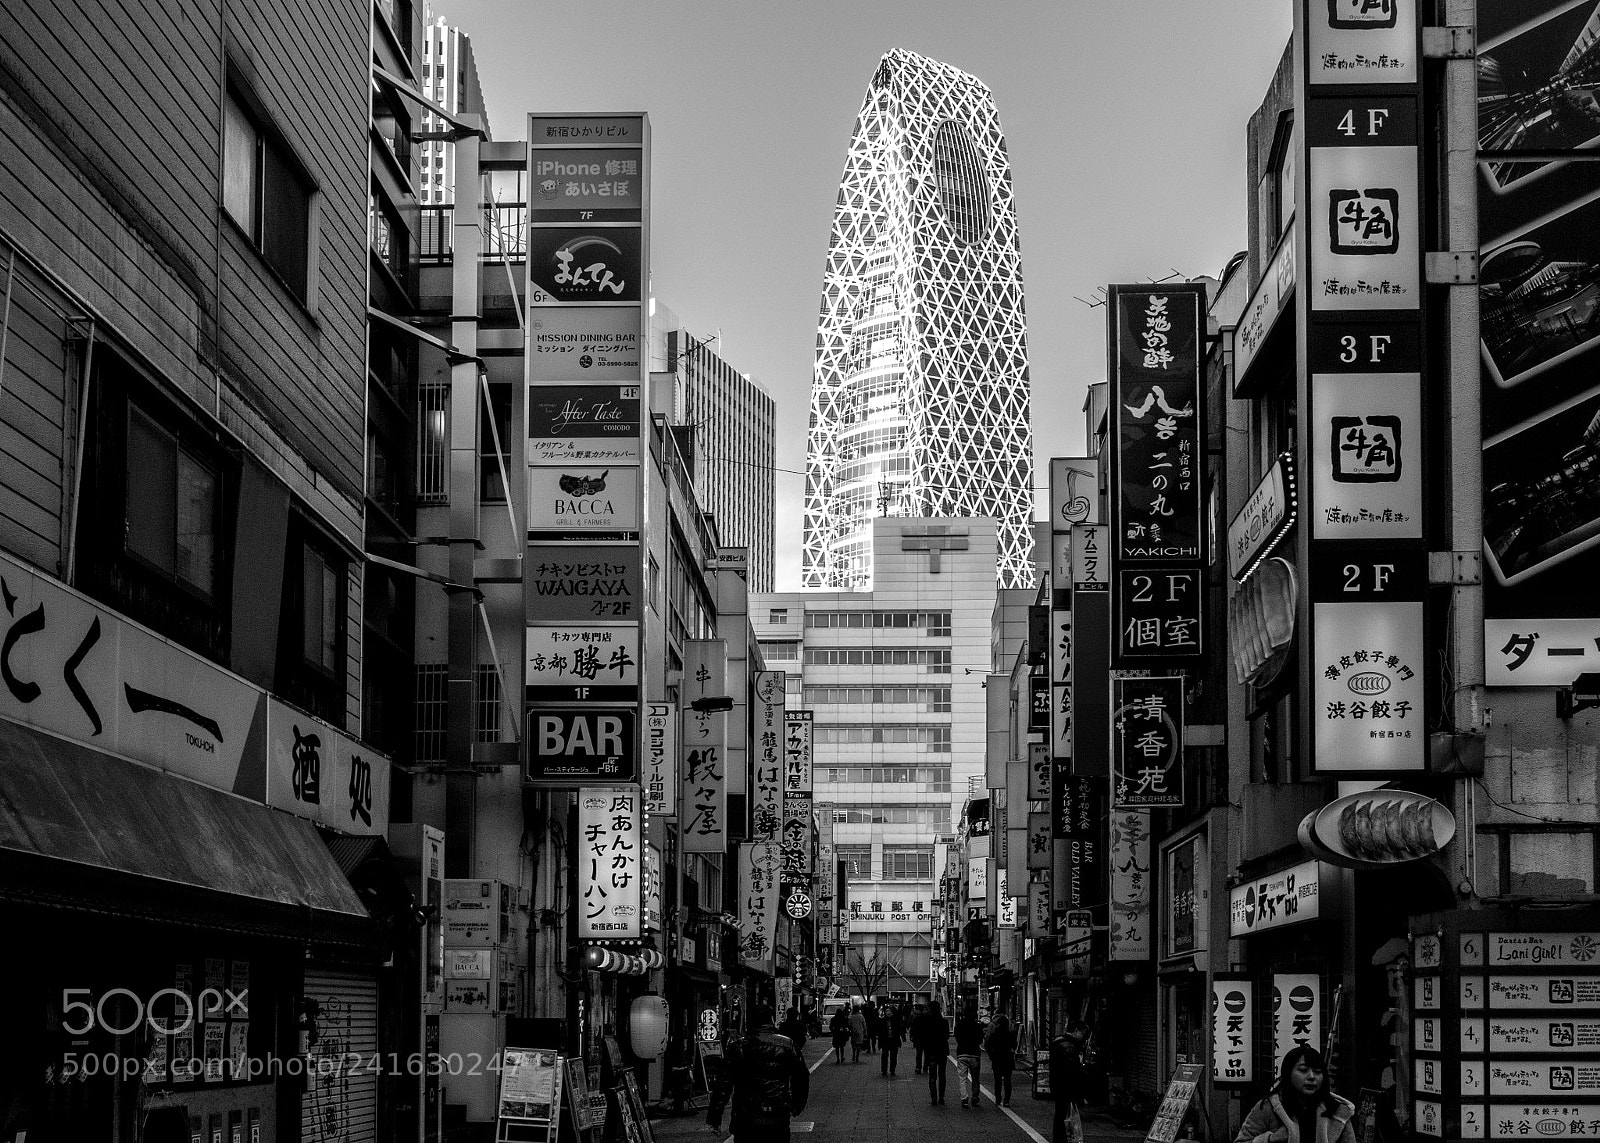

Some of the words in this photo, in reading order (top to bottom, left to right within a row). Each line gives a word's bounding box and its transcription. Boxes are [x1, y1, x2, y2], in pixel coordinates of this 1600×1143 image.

[546, 125, 629, 137] 新宿ひかりビル
[1336, 108, 1389, 136] 4F
[536, 160, 601, 176] iPhone
[604, 159, 638, 177] 修理
[565, 181, 630, 197] あいさぽ
[579, 210, 594, 220] 7F
[1338, 200, 1392, 240] 牛角
[553, 247, 625, 295] まんてん
[533, 290, 548, 302] 6F
[537, 333, 578, 342] MISSION
[580, 333, 614, 342] DINING
[615, 333, 636, 342] BAR
[536, 345, 575, 353] ミッション
[582, 345, 636, 353] ダイニングバー
[1339, 335, 1392, 363] 3F
[623, 388, 639, 398] 4F
[551, 397, 590, 434] After
[591, 400, 624, 421] Taste
[1340, 427, 1395, 468] 牛角
[1178, 439, 1191, 491] 新宿西口
[1147, 452, 1175, 517] 二の丸
[554, 499, 615, 515] BACCA
[1083, 527, 1098, 582] オムニクス
[1124, 546, 1198, 557] YAKICHI
[535, 562, 628, 578] チキンビストロ
[1342, 563, 1396, 592] 2F
[534, 578, 632, 597] WAIGAYA
[1131, 574, 1193, 603] 2F
[612, 601, 631, 616] 2F
[550, 631, 613, 643] 牛カツ専門店
[1123, 614, 1198, 648] 個室
[1500, 631, 1600, 672] ダー
[1324, 649, 1415, 681] 薄皮餃子専門
[574, 687, 590, 700] 1F
[1326, 700, 1413, 720] 渋谷餃子
[538, 715, 624, 756] BAR
[1132, 693, 1169, 795] 清香苑
[1369, 730, 1412, 739] 新宿西口店
[787, 722, 803, 790] アカマル屋
[683, 747, 724, 835] 段々屋
[608, 794, 635, 889] 肉あんかけ
[584, 823, 608, 919] チャーハン
[850, 913, 886, 921] SHINJUKU
[890, 913, 911, 921] POST
[1463, 938, 1481, 959] 6F
[1529, 936, 1544, 944] Bar
[1496, 945, 1530, 961] Lani
[1463, 982, 1480, 1002] 5F
[1551, 984, 1574, 1000] 牛角
[1463, 1025, 1481, 1045] 4F
[1551, 1027, 1574, 1043] 牛角
[1224, 1015, 1246, 1078] 天下一品
[1464, 1068, 1481, 1088] 3F
[1552, 1070, 1574, 1086] 牛角
[1465, 1111, 1481, 1133] 2F
[1499, 1119, 1533, 1136] 渋谷
[1568, 1119, 1600, 1136] 餃子
